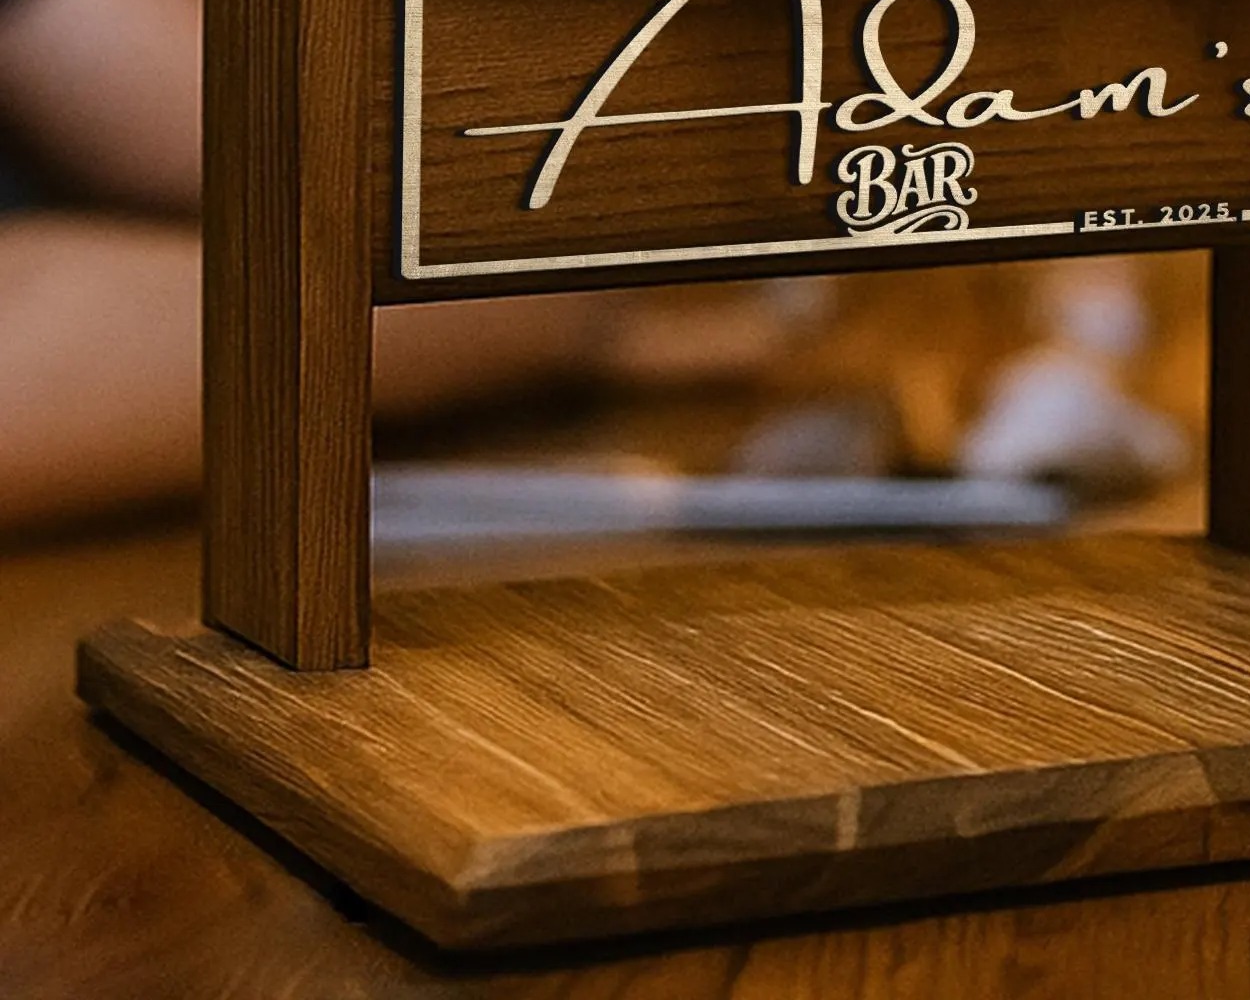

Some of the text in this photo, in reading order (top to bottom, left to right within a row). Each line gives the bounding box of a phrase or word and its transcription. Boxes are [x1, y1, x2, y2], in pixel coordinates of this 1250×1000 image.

[836, 141, 979, 226] BAR
[1084, 202, 1230, 229] EST. 2025
